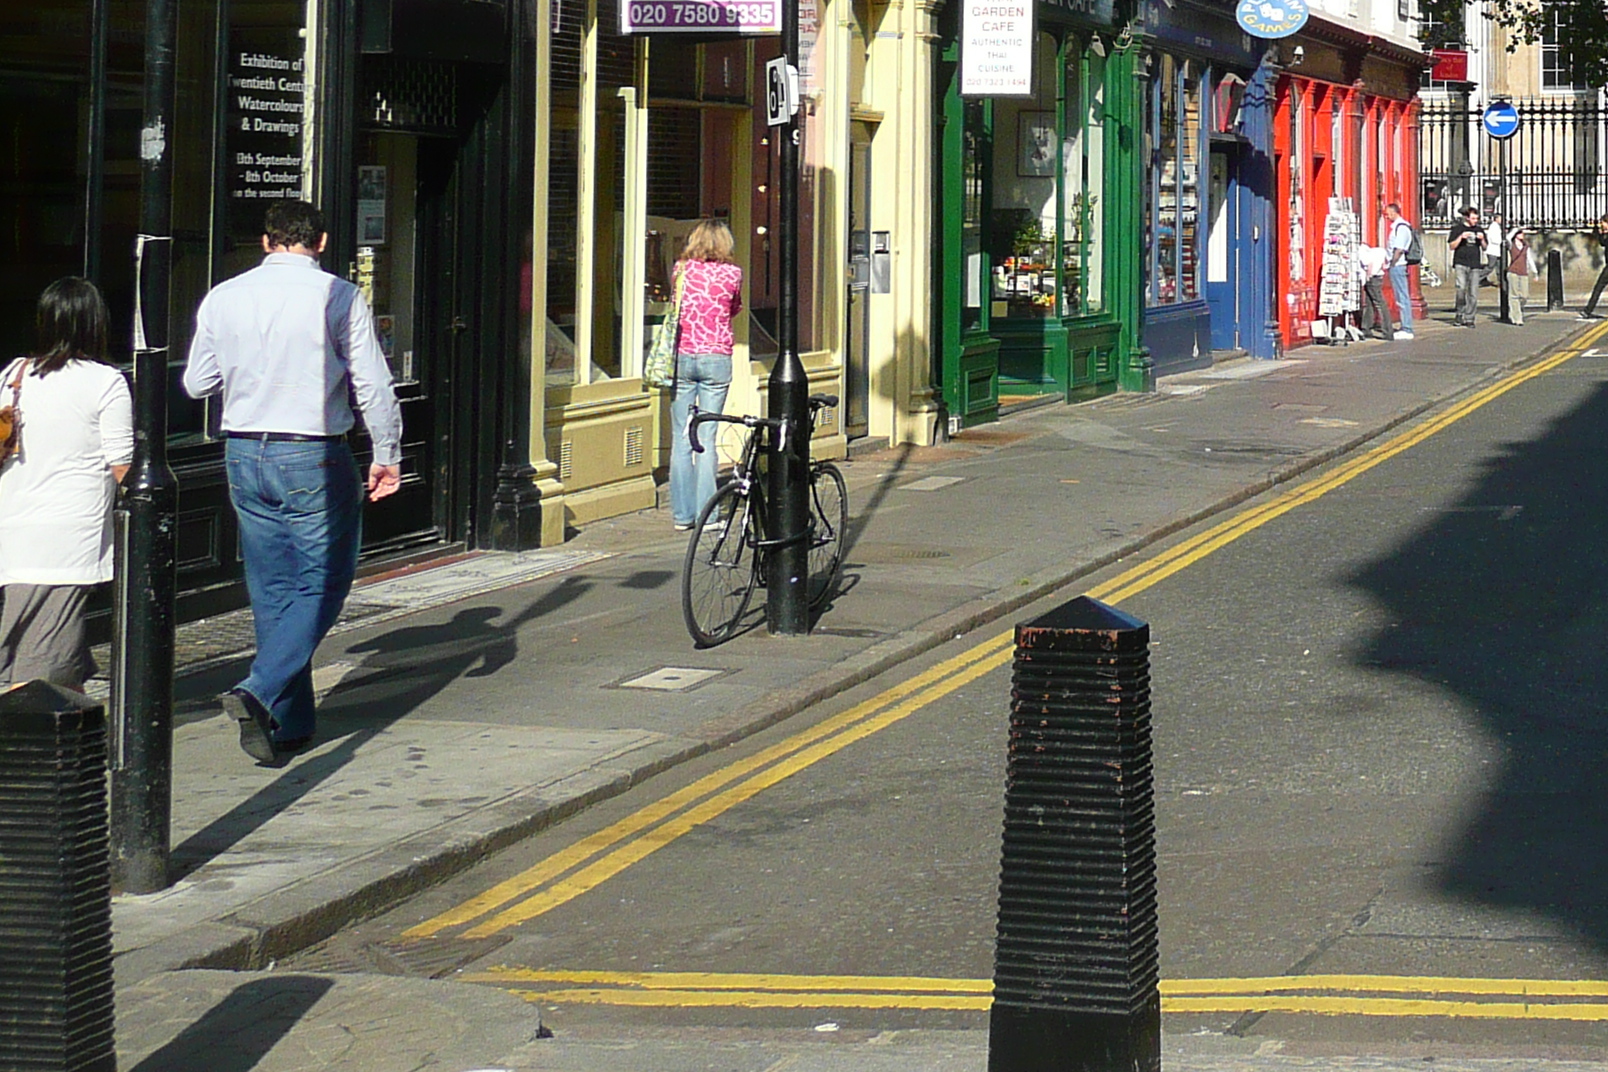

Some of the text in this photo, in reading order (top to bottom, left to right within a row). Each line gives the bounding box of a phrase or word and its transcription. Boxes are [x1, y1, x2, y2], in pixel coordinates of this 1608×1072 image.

[631, 4, 774, 23] 020 7580 9335
[972, 6, 1025, 17] GARDEN
[982, 21, 1015, 32] CAFE
[1242, 13, 1302, 33] GAMES
[971, 38, 1023, 46] AUTHENTIC
[240, 53, 303, 71] Exhibition of
[987, 51, 1007, 59] THAI
[978, 64, 1015, 72] CUISINE
[227, 74, 276, 91] Twentieth
[238, 95, 304, 113] Watercolours
[241, 117, 300, 137] & Drawings
[255, 153, 301, 168] September
[262, 171, 298, 184] October
